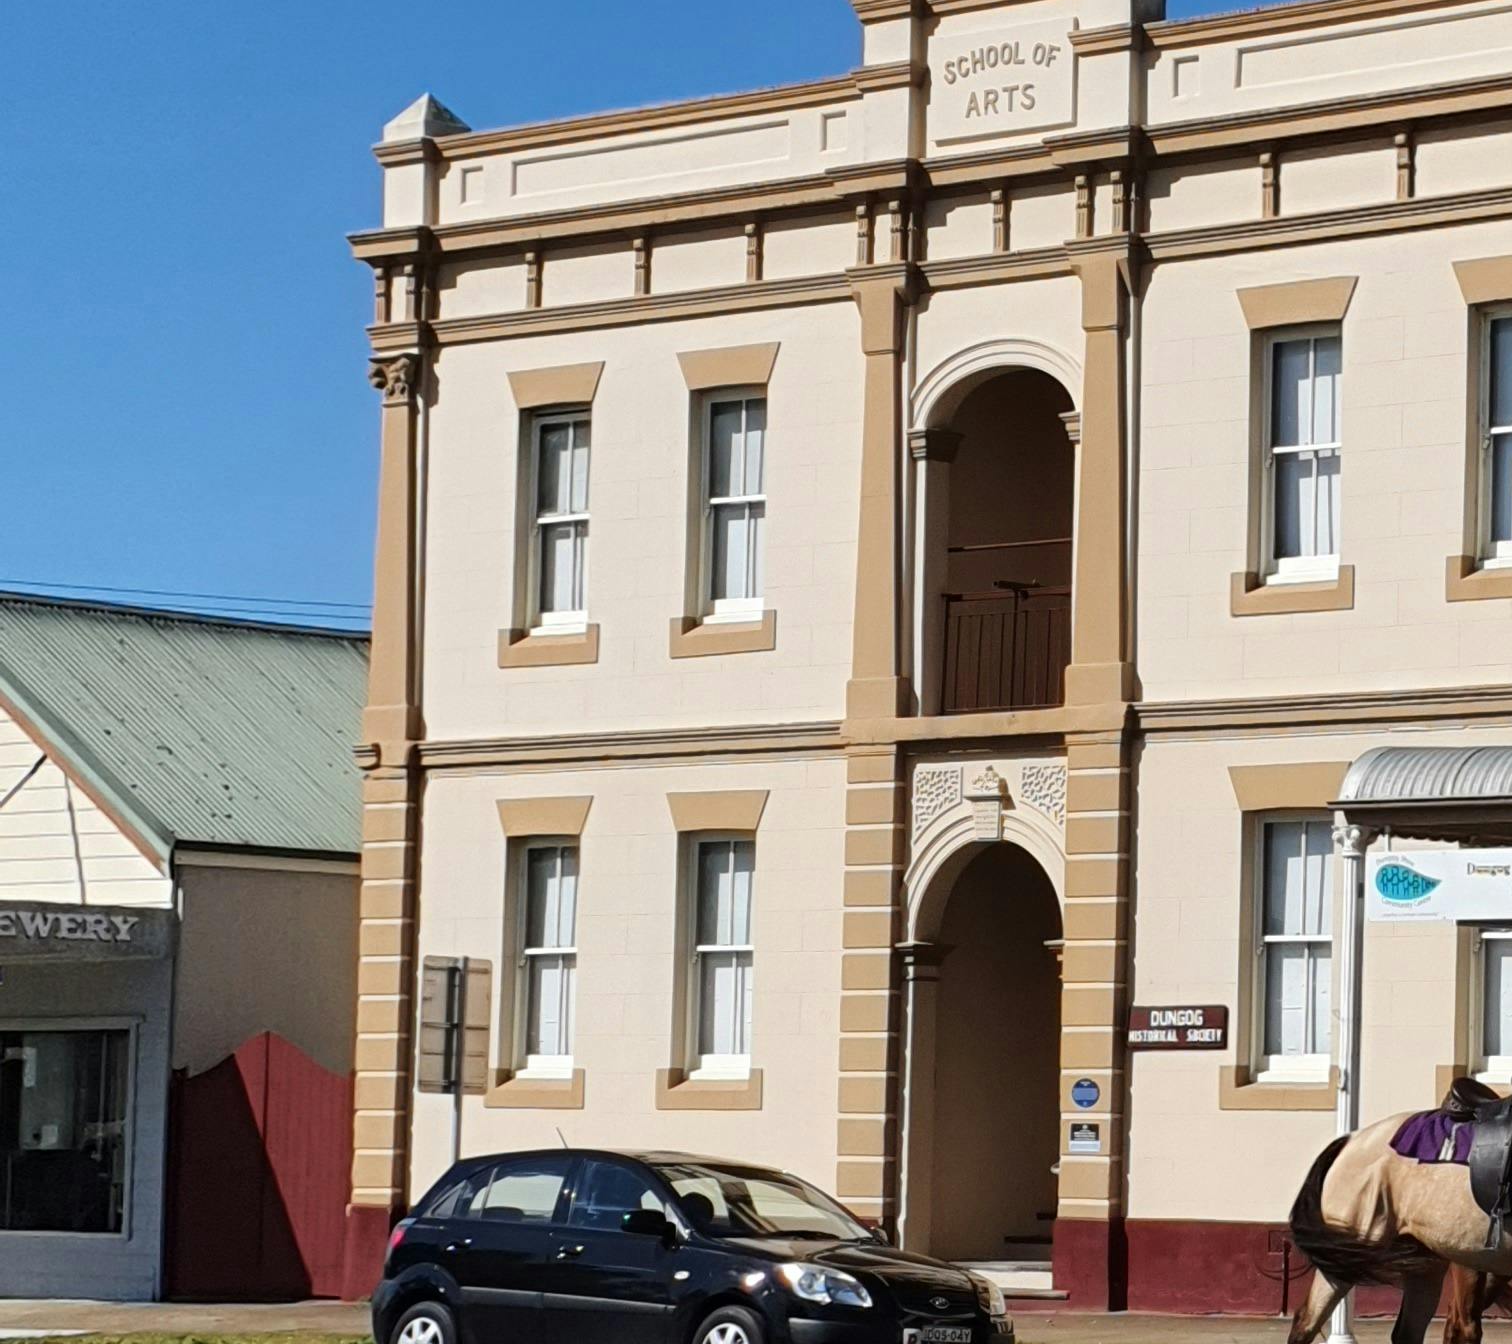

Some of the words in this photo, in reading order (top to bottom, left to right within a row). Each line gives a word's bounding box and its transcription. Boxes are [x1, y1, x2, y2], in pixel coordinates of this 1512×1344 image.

[943, 40, 1026, 85] SCHOOL
[1032, 42, 1062, 68] OF
[965, 83, 1037, 119] ARTS
[0, 910, 140, 941] EWERY
[1150, 1009, 1204, 1027] DUNGOG
[1127, 1029, 1179, 1042] HISTORICAL
[1185, 1028, 1223, 1042] SOCIETY
